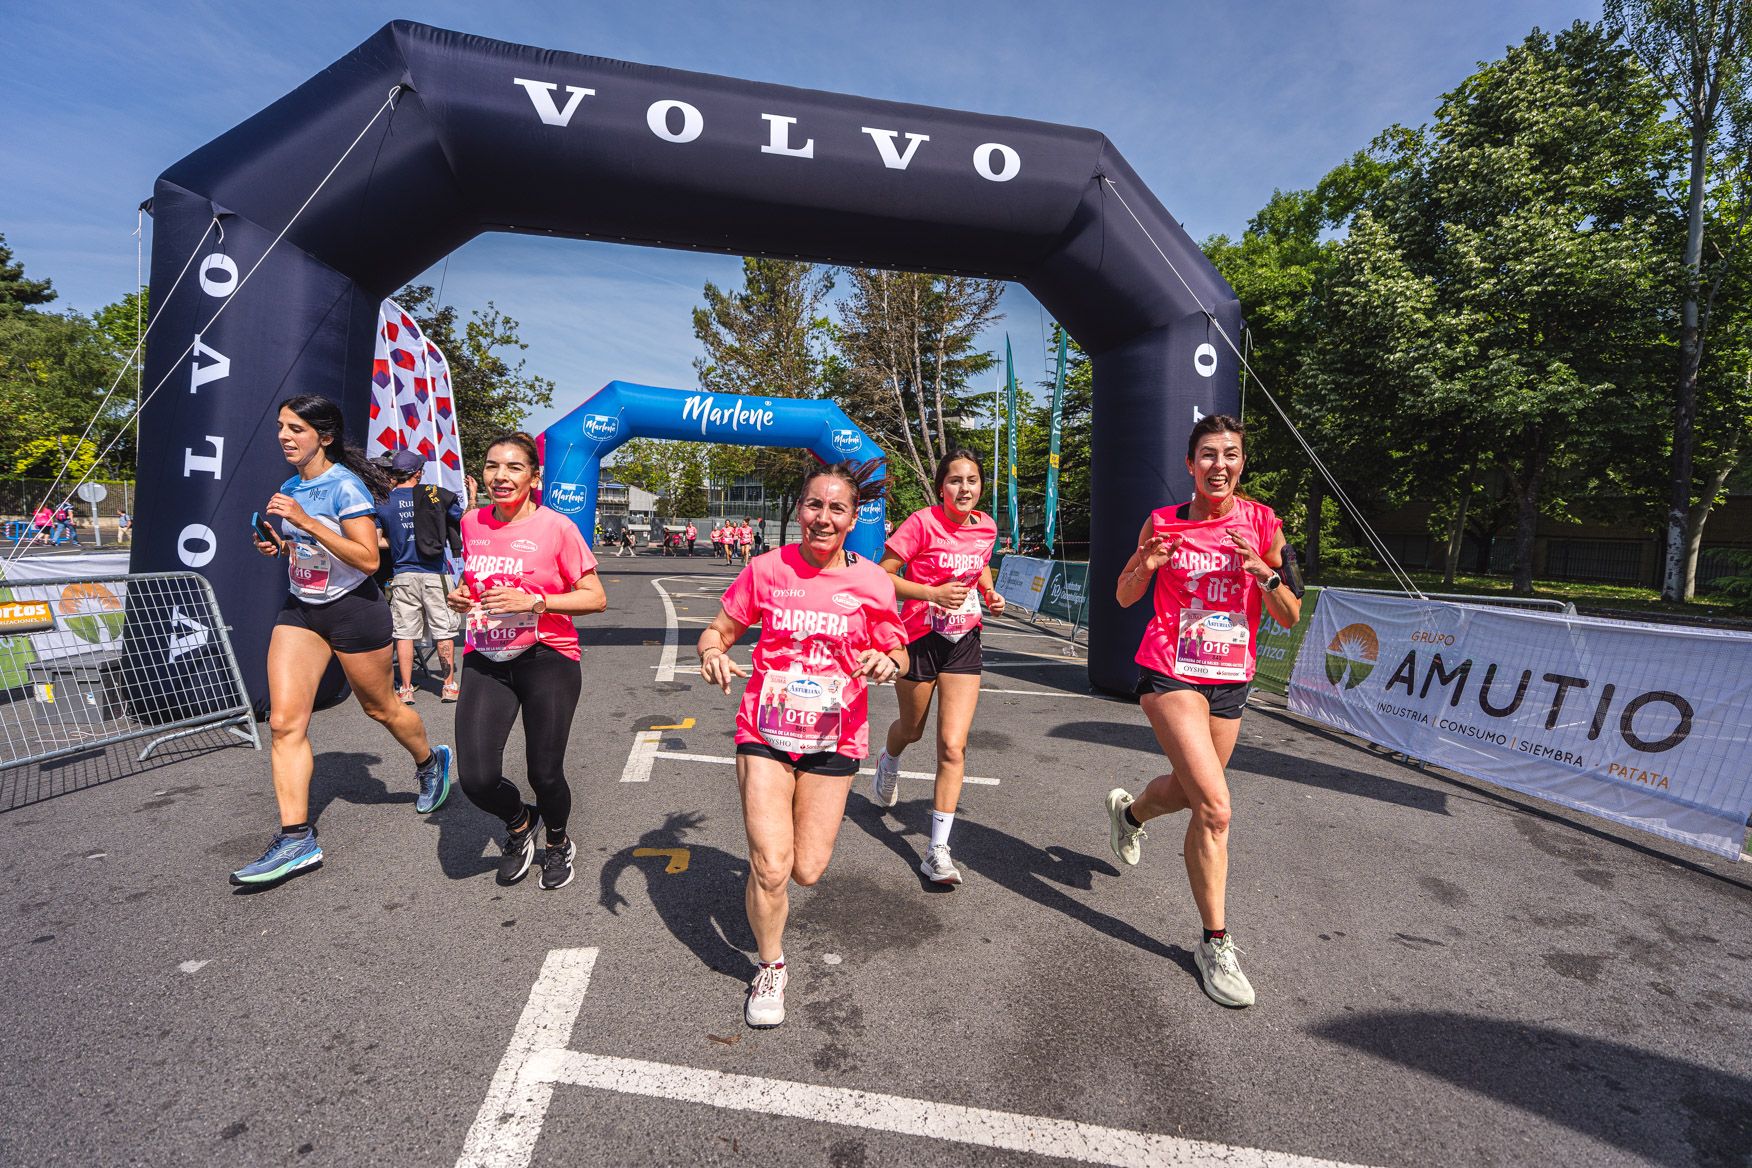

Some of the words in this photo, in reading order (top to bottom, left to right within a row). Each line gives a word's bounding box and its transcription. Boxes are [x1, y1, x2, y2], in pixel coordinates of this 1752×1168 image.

[514, 77, 1021, 182] VOLVO
[682, 395, 773, 436] Marlene
[586, 420, 616, 433] Marlene
[833, 434, 860, 447] Marlene
[168, 252, 239, 664] VOLVO
[551, 488, 584, 504] Marlene
[465, 554, 524, 575] CARRERA
[939, 552, 984, 570] CARRERA
[1170, 551, 1241, 572] CARRERA
[773, 588, 806, 598] OYSHO
[1207, 577, 1231, 603] DE
[772, 608, 849, 638] CARRERA
[949, 615, 967, 625] 016
[490, 628, 517, 640] 016
[1411, 630, 1456, 647] GRUPO
[1203, 641, 1230, 655] 016
[1256, 645, 1286, 661] anza
[1183, 664, 1209, 674] OYSHO
[1384, 649, 1695, 754] AMUTIO
[786, 709, 818, 725] 016
[1376, 701, 1429, 725] INDUSTRIA
[1438, 718, 1507, 746] CONSUMO
[1518, 739, 1584, 768] SIEMBRA
[1608, 762, 1671, 790] PATATA
